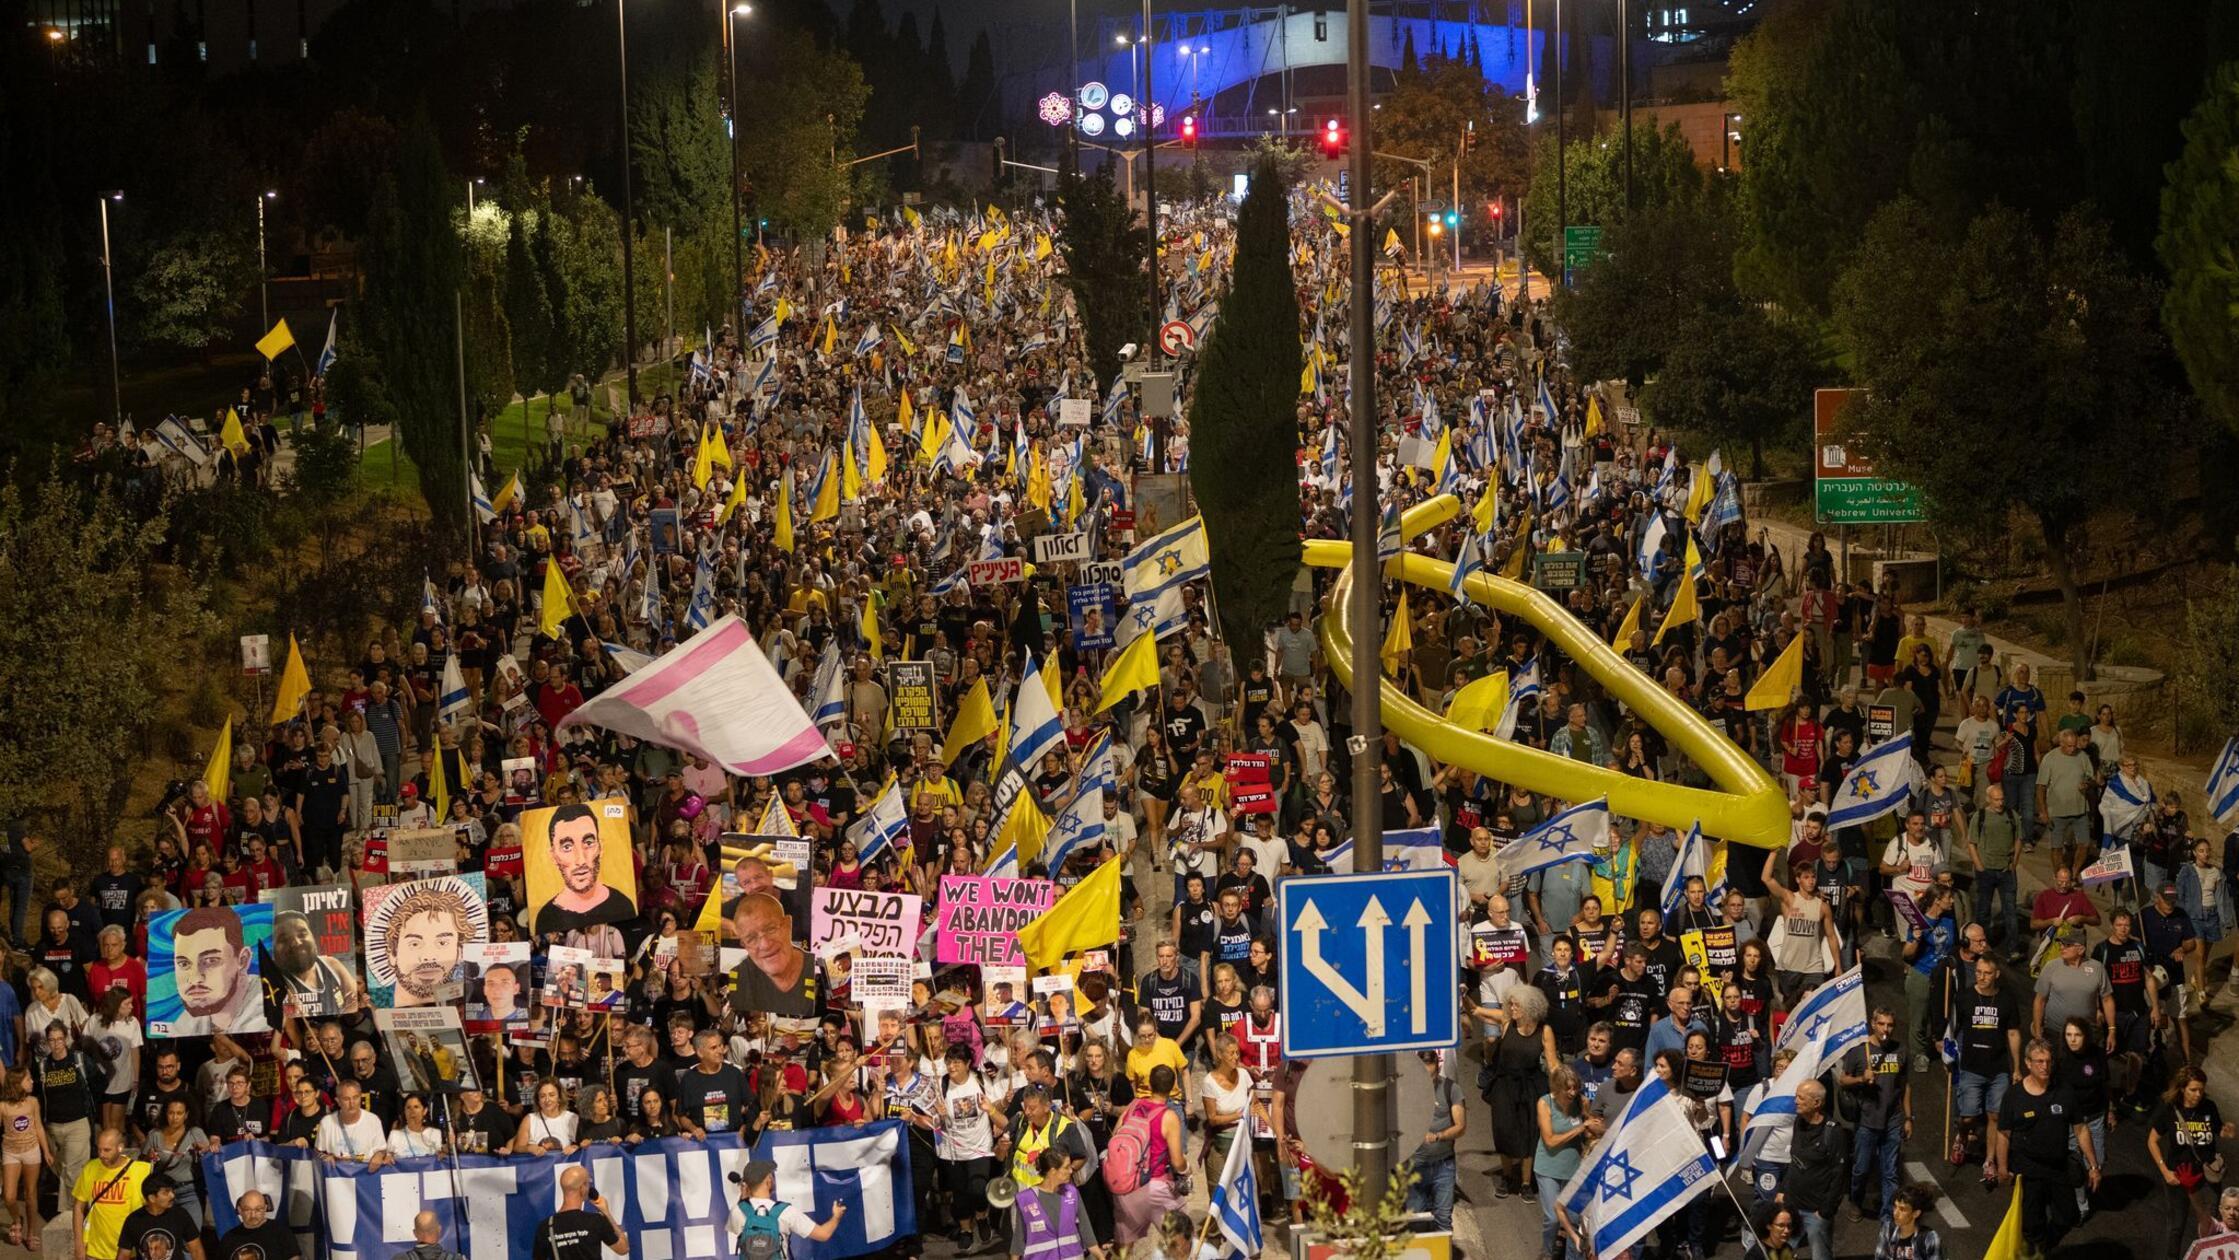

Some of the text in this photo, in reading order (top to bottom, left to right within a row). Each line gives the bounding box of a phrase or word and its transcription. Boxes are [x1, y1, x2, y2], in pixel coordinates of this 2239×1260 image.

[1848, 464, 1872, 473] Muse
[1824, 482, 1863, 492] העברית
[1082, 565, 1124, 585] סתכלו
[944, 880, 980, 902] WE
[302, 888, 348, 914] לאיתן
[823, 891, 903, 920] מבצע
[325, 912, 350, 936] אין
[820, 918, 903, 948] הפקרת
[1220, 933, 1251, 944] נאמנים
[1152, 996, 1184, 1010] בחירות
[153, 1023, 169, 1034] בר
[93, 1181, 127, 1200] NOW
